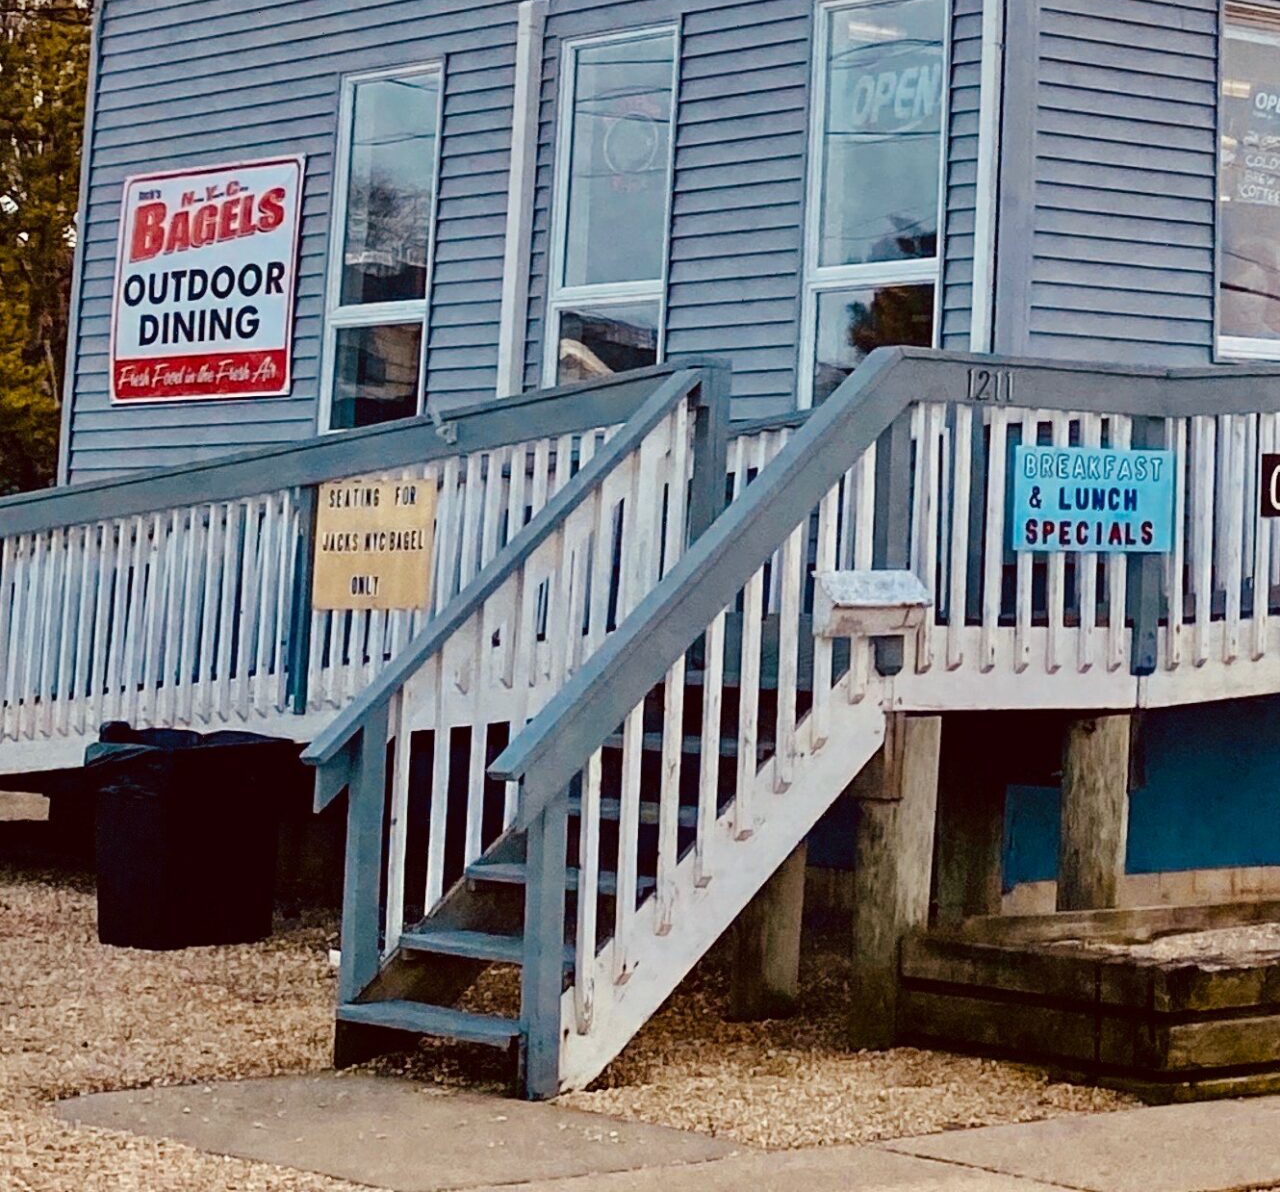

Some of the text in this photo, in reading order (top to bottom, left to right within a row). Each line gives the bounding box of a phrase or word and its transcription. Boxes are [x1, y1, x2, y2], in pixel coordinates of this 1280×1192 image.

[852, 63, 941, 125] OPEN
[129, 187, 286, 263] BAGELS
[123, 262, 285, 307] OUTDOOR
[138, 305, 260, 346] DINING
[966, 368, 1014, 402] 1211
[1024, 453, 1164, 481] BREAKFAST
[329, 486, 416, 508] SEATING FOR
[1029, 485, 1137, 511] & LUNCH
[322, 533, 358, 551] JACKS
[389, 530, 424, 551] BAGEL
[1025, 518, 1154, 545] SPECIALS
[351, 576, 379, 595] ONLY
